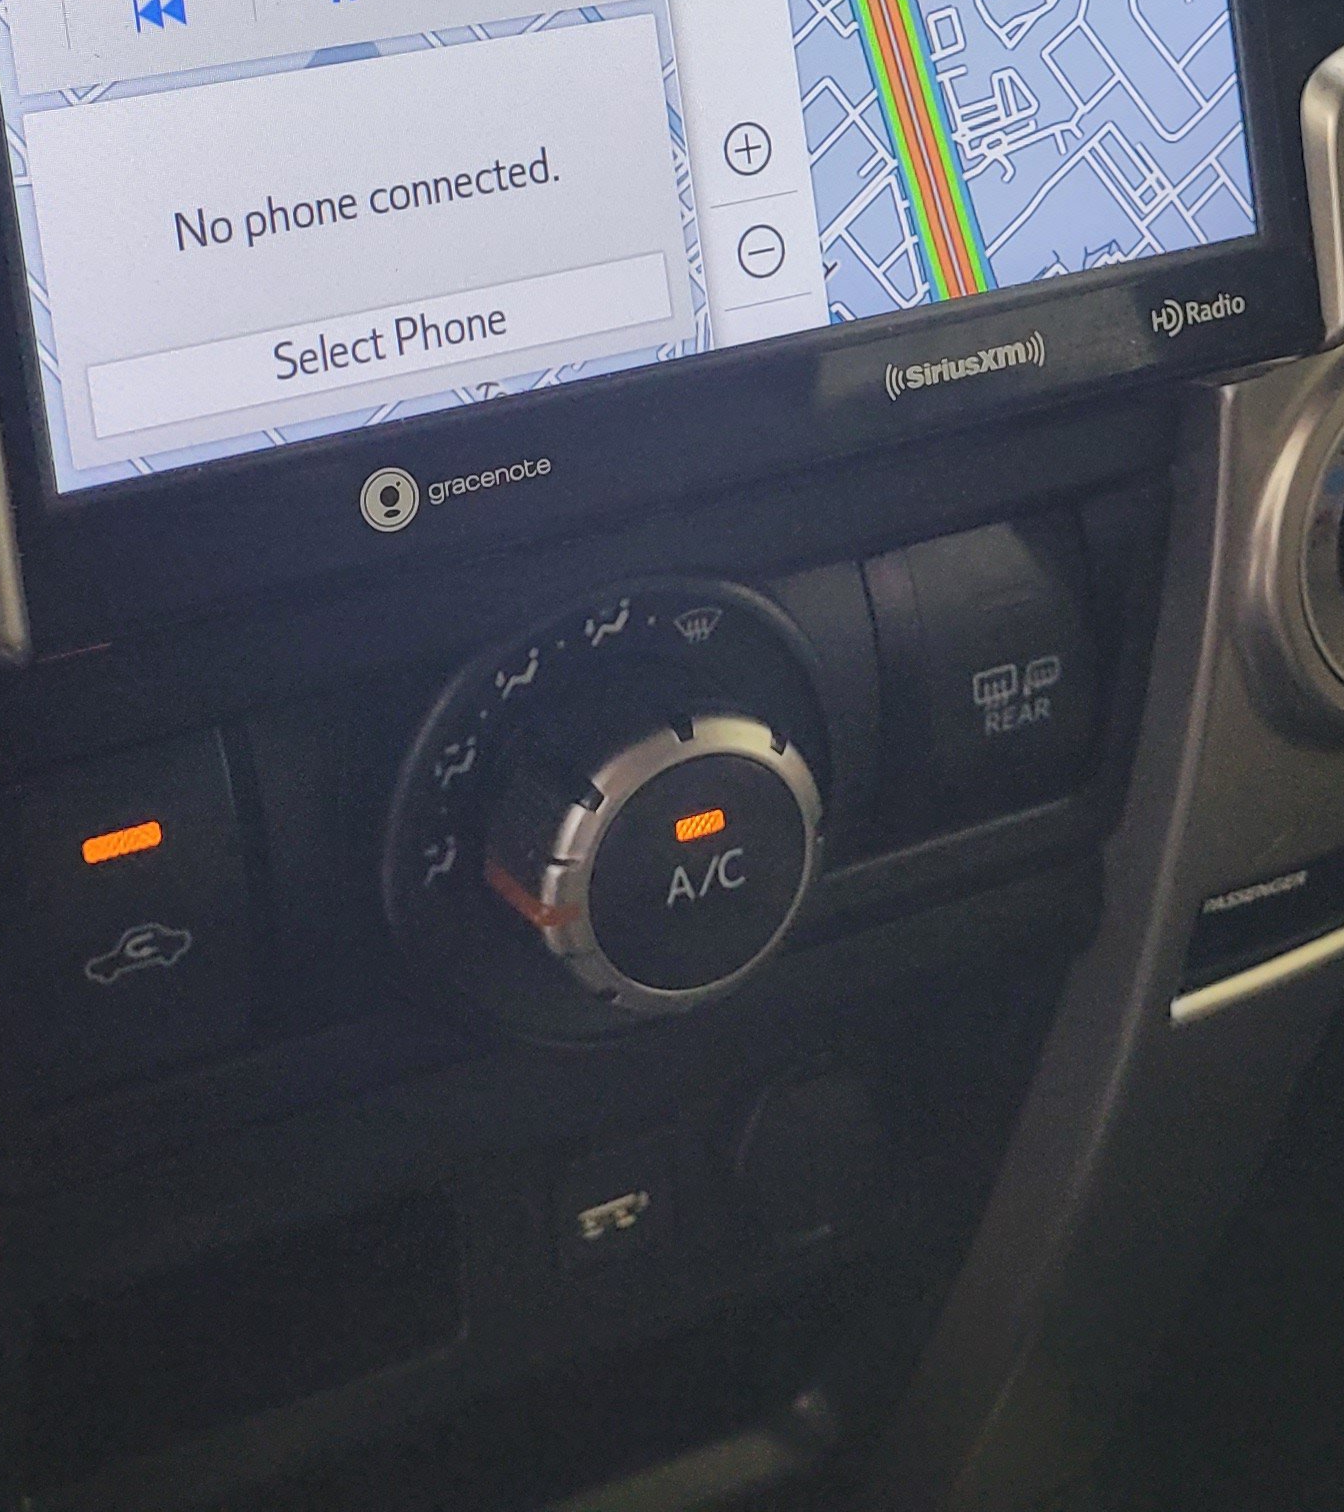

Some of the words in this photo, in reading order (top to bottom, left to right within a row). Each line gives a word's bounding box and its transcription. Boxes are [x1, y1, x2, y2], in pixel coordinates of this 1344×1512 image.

[173, 206, 234, 252] No
[245, 190, 358, 248] phone
[369, 147, 562, 215] connected.
[1186, 292, 1246, 326] Radio
[272, 328, 386, 381] Select
[394, 304, 509, 356] Phone
[427, 454, 553, 507] gracenote
[984, 698, 1052, 735] REAR
[666, 847, 747, 907] A/C
